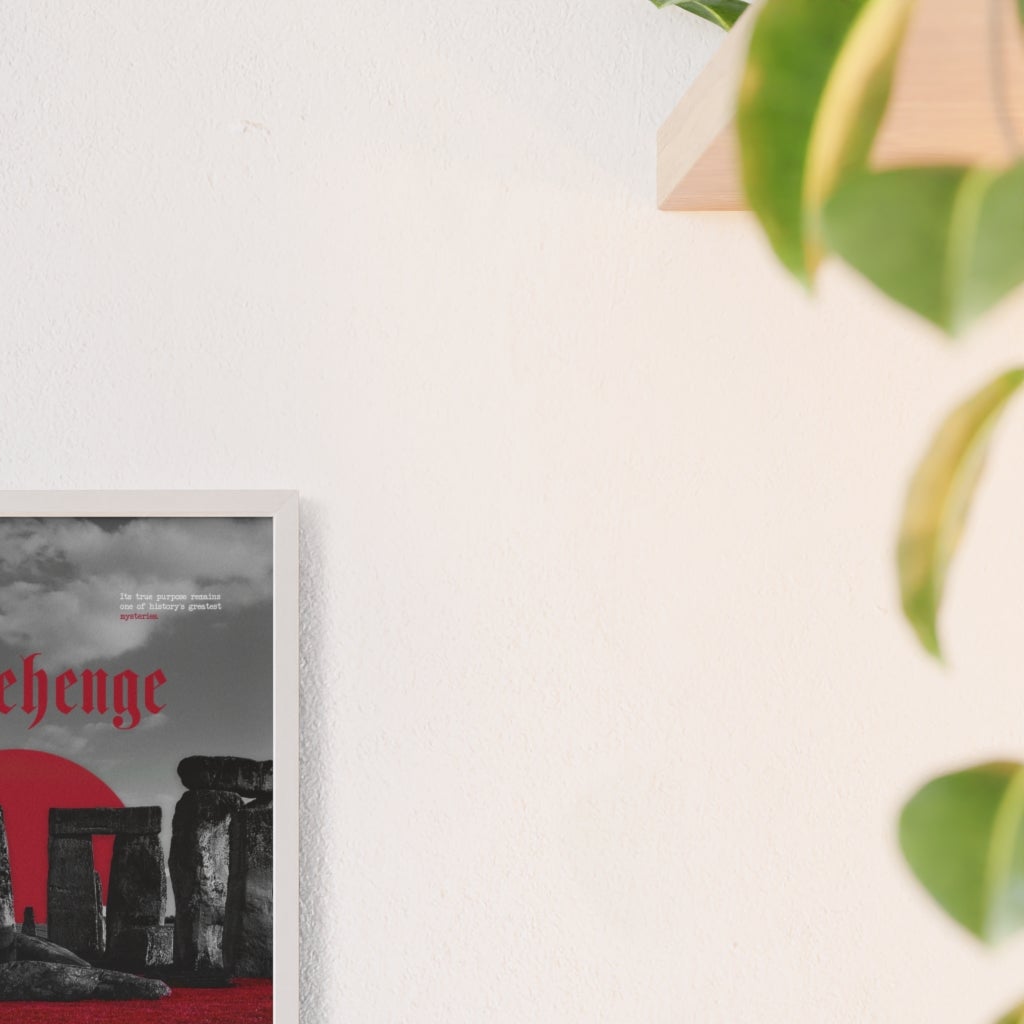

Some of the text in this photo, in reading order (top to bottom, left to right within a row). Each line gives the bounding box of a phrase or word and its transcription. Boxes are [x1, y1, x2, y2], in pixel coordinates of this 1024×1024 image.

[120, 592, 221, 602] Its true purpose remains
[136, 602, 146, 610] of
[149, 602, 185, 612] history's
[188, 602, 222, 612] greatest
